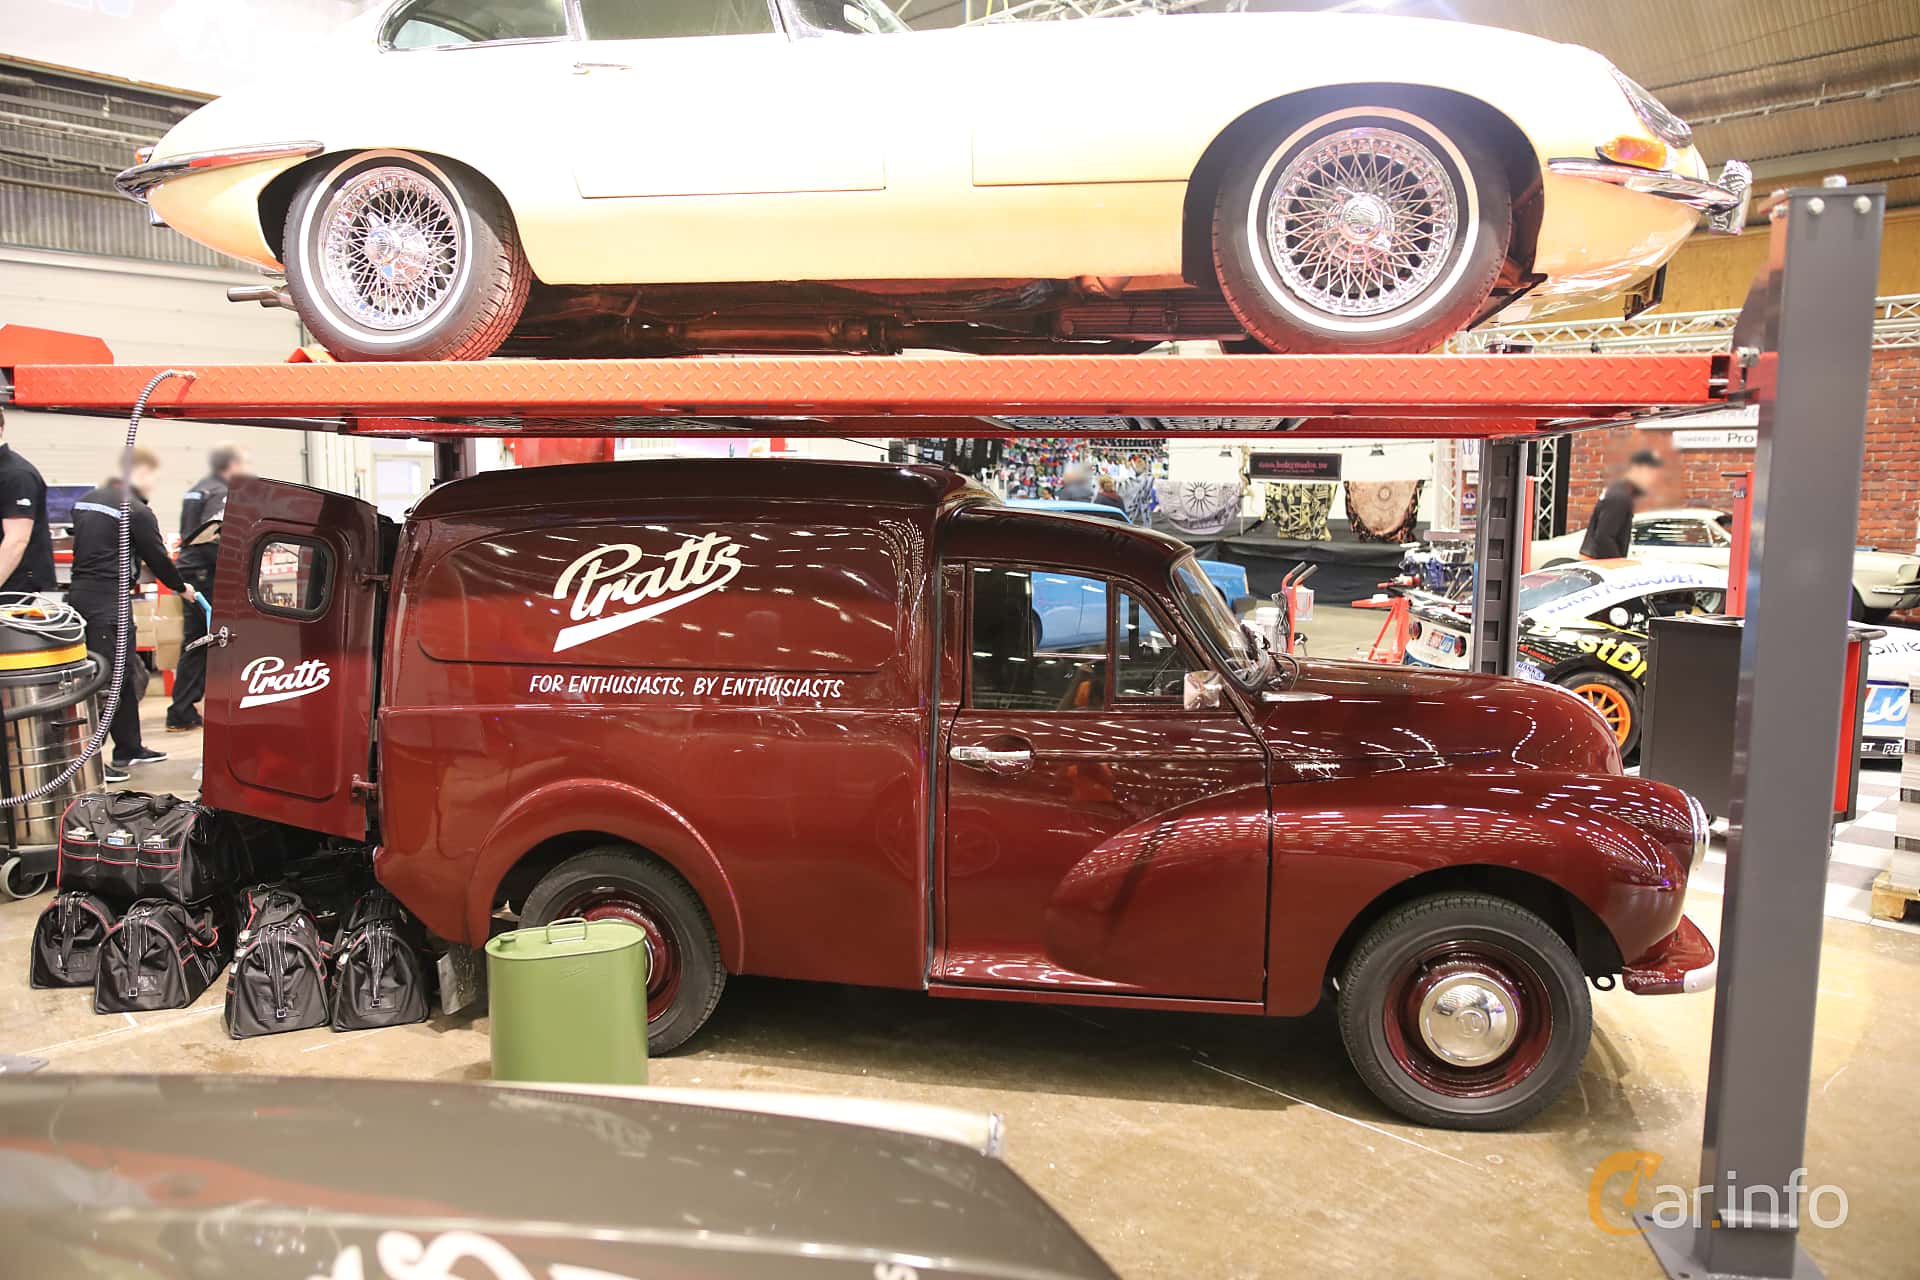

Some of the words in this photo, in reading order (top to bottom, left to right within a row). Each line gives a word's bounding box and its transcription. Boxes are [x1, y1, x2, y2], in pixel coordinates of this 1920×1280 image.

[553, 532, 743, 653] Pratts
[239, 656, 331, 709] Pratts
[529, 675, 563, 693] FOR
[568, 675, 686, 697] ENTHUSIASTS,
[693, 677, 717, 695] BY
[721, 678, 845, 698] ENTHUSIASTS
